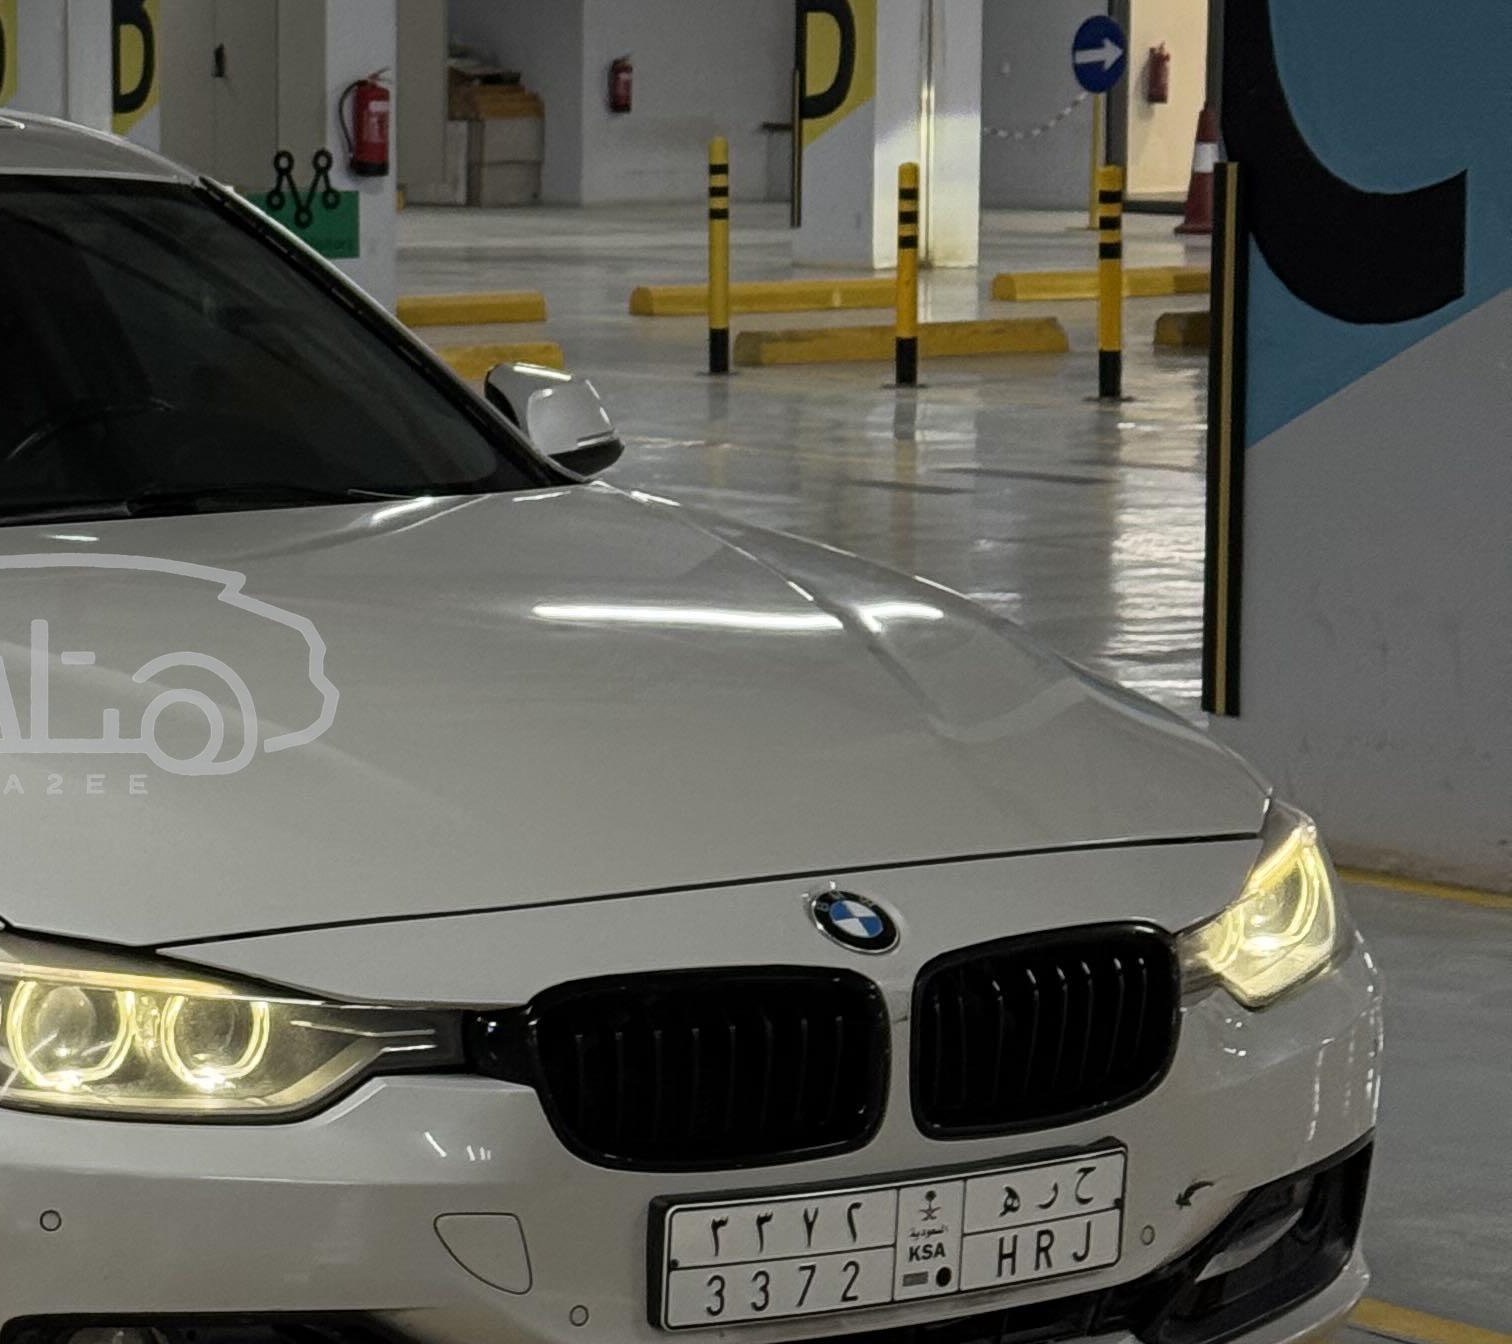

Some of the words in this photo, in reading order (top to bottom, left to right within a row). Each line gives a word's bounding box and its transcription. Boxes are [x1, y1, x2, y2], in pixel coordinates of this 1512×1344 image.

[908, 1242, 947, 1263] KSA
[996, 1220, 1092, 1278] HRJ
[706, 1260, 861, 1317] 3372
